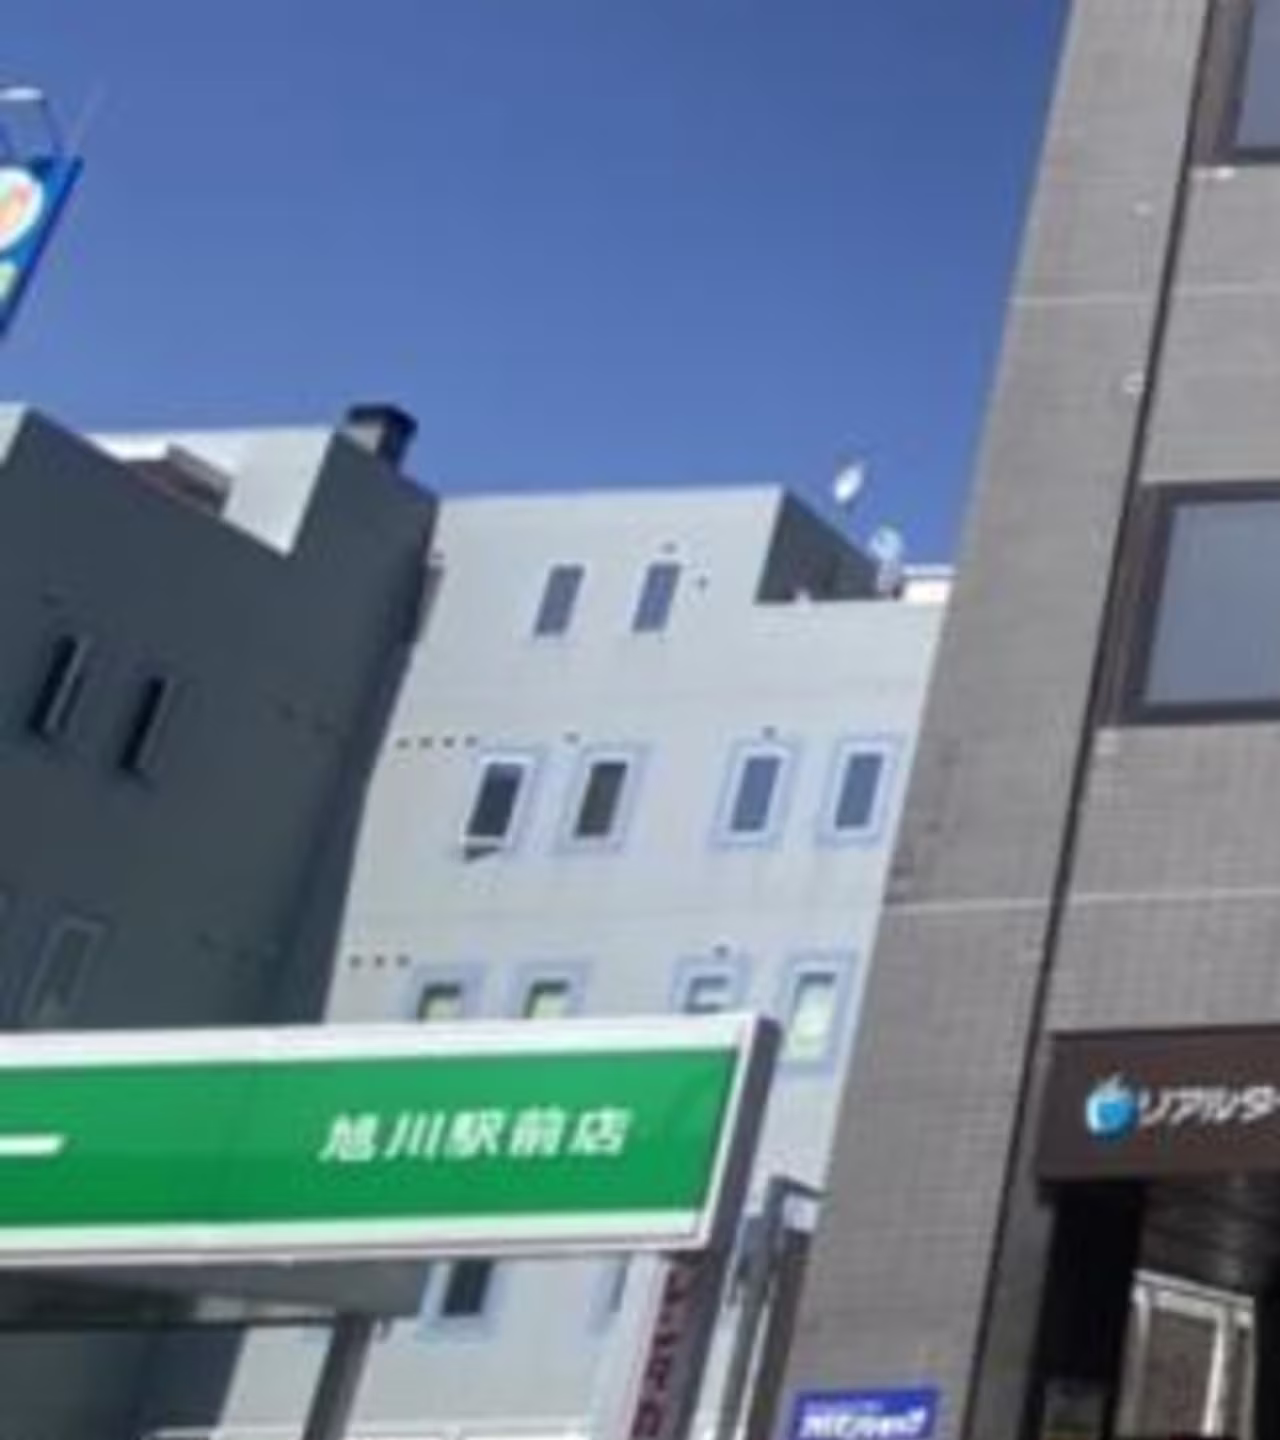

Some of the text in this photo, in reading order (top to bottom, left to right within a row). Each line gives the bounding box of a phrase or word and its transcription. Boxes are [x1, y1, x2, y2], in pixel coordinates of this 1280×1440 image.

[318, 1105, 635, 1162] 旭川駅前店
